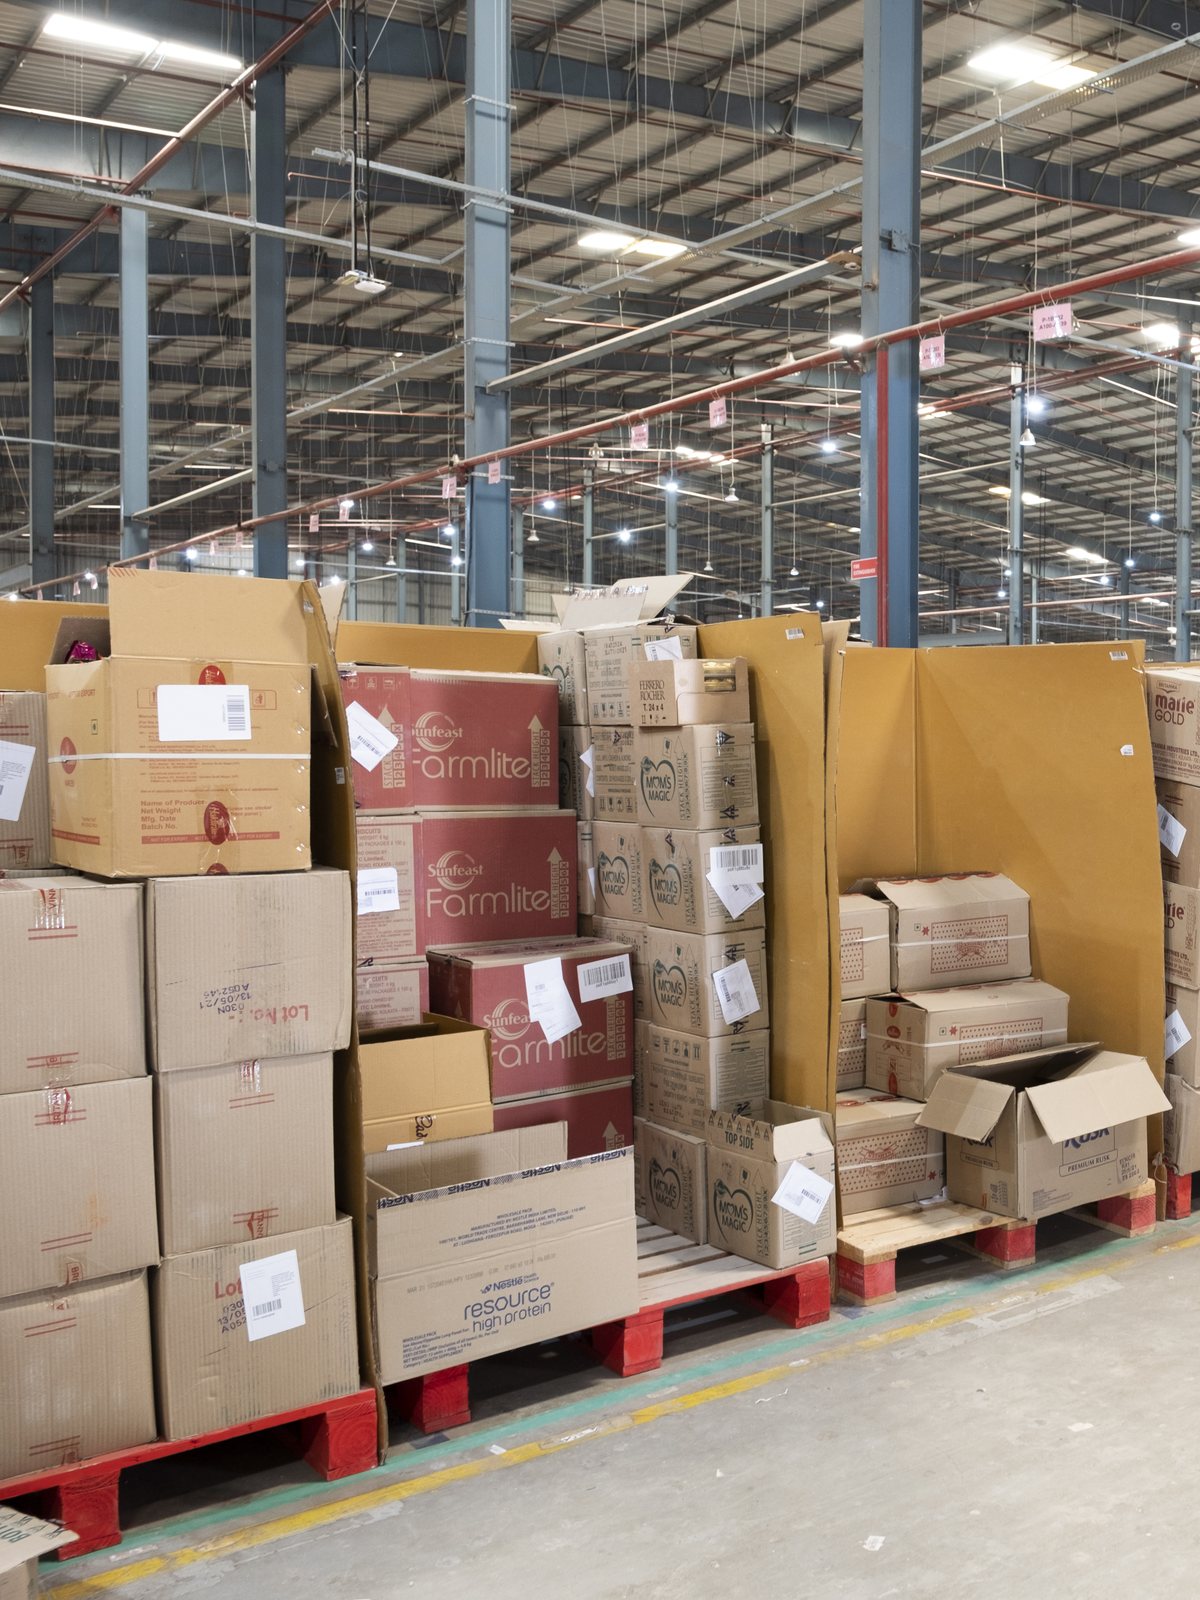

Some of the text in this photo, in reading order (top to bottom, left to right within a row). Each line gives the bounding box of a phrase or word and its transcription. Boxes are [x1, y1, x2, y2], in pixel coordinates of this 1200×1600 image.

[640, 680, 665, 690] FERRERO
[640, 690, 665, 701] ROCHER
[1155, 694, 1195, 715] marie
[648, 703, 655, 711] 24
[660, 703, 664, 711] 4
[1154, 709, 1185, 726] GOLD
[648, 790, 671, 802] MAGIC
[141, 815, 156, 823] Mfg.
[428, 863, 484, 879] Sunfeast
[550, 863, 559, 919] STACK HEIGHT
[604, 882, 625, 896] MAGIC
[426, 882, 550, 919] Farmlite
[656, 891, 677, 906] MAGIC
[685, 901, 693, 926] STACK
[660, 993, 682, 1007] MAGIC
[281, 1004, 309, 1024] Lot
[607, 1032, 615, 1060] STACK
[724, 1131, 755, 1151] TOP SIDE
[1067, 1154, 1111, 1173] PREMIUM RUSK
[655, 1193, 677, 1210] MAGIC
[721, 1215, 749, 1233] MAGIC
[756, 1228, 764, 1254] STACK
[214, 1276, 243, 1300] Lot
[463, 1284, 551, 1320] resource
[473, 1302, 551, 1333] high protein
